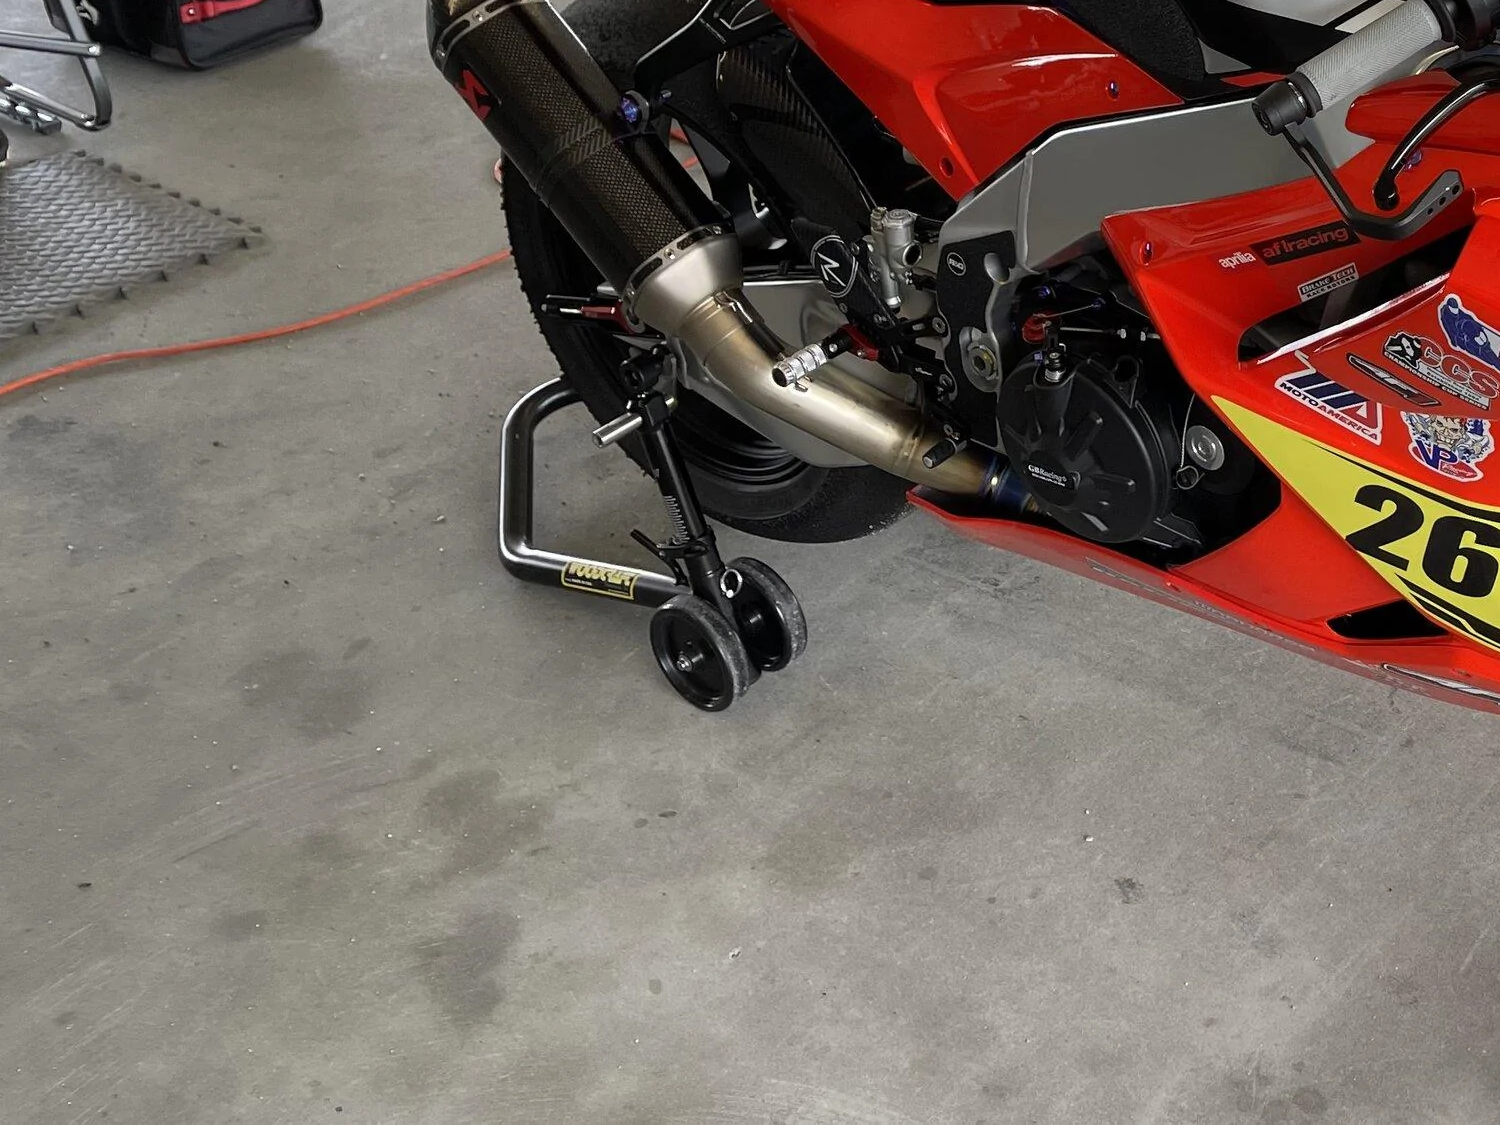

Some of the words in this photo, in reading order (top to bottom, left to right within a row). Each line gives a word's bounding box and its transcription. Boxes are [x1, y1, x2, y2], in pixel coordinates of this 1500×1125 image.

[1218, 250, 1256, 270] aprilia
[1418, 336, 1500, 399] CCS
[1279, 382, 1378, 441] MOTOAMERICA
[1416, 439, 1458, 471] VP
